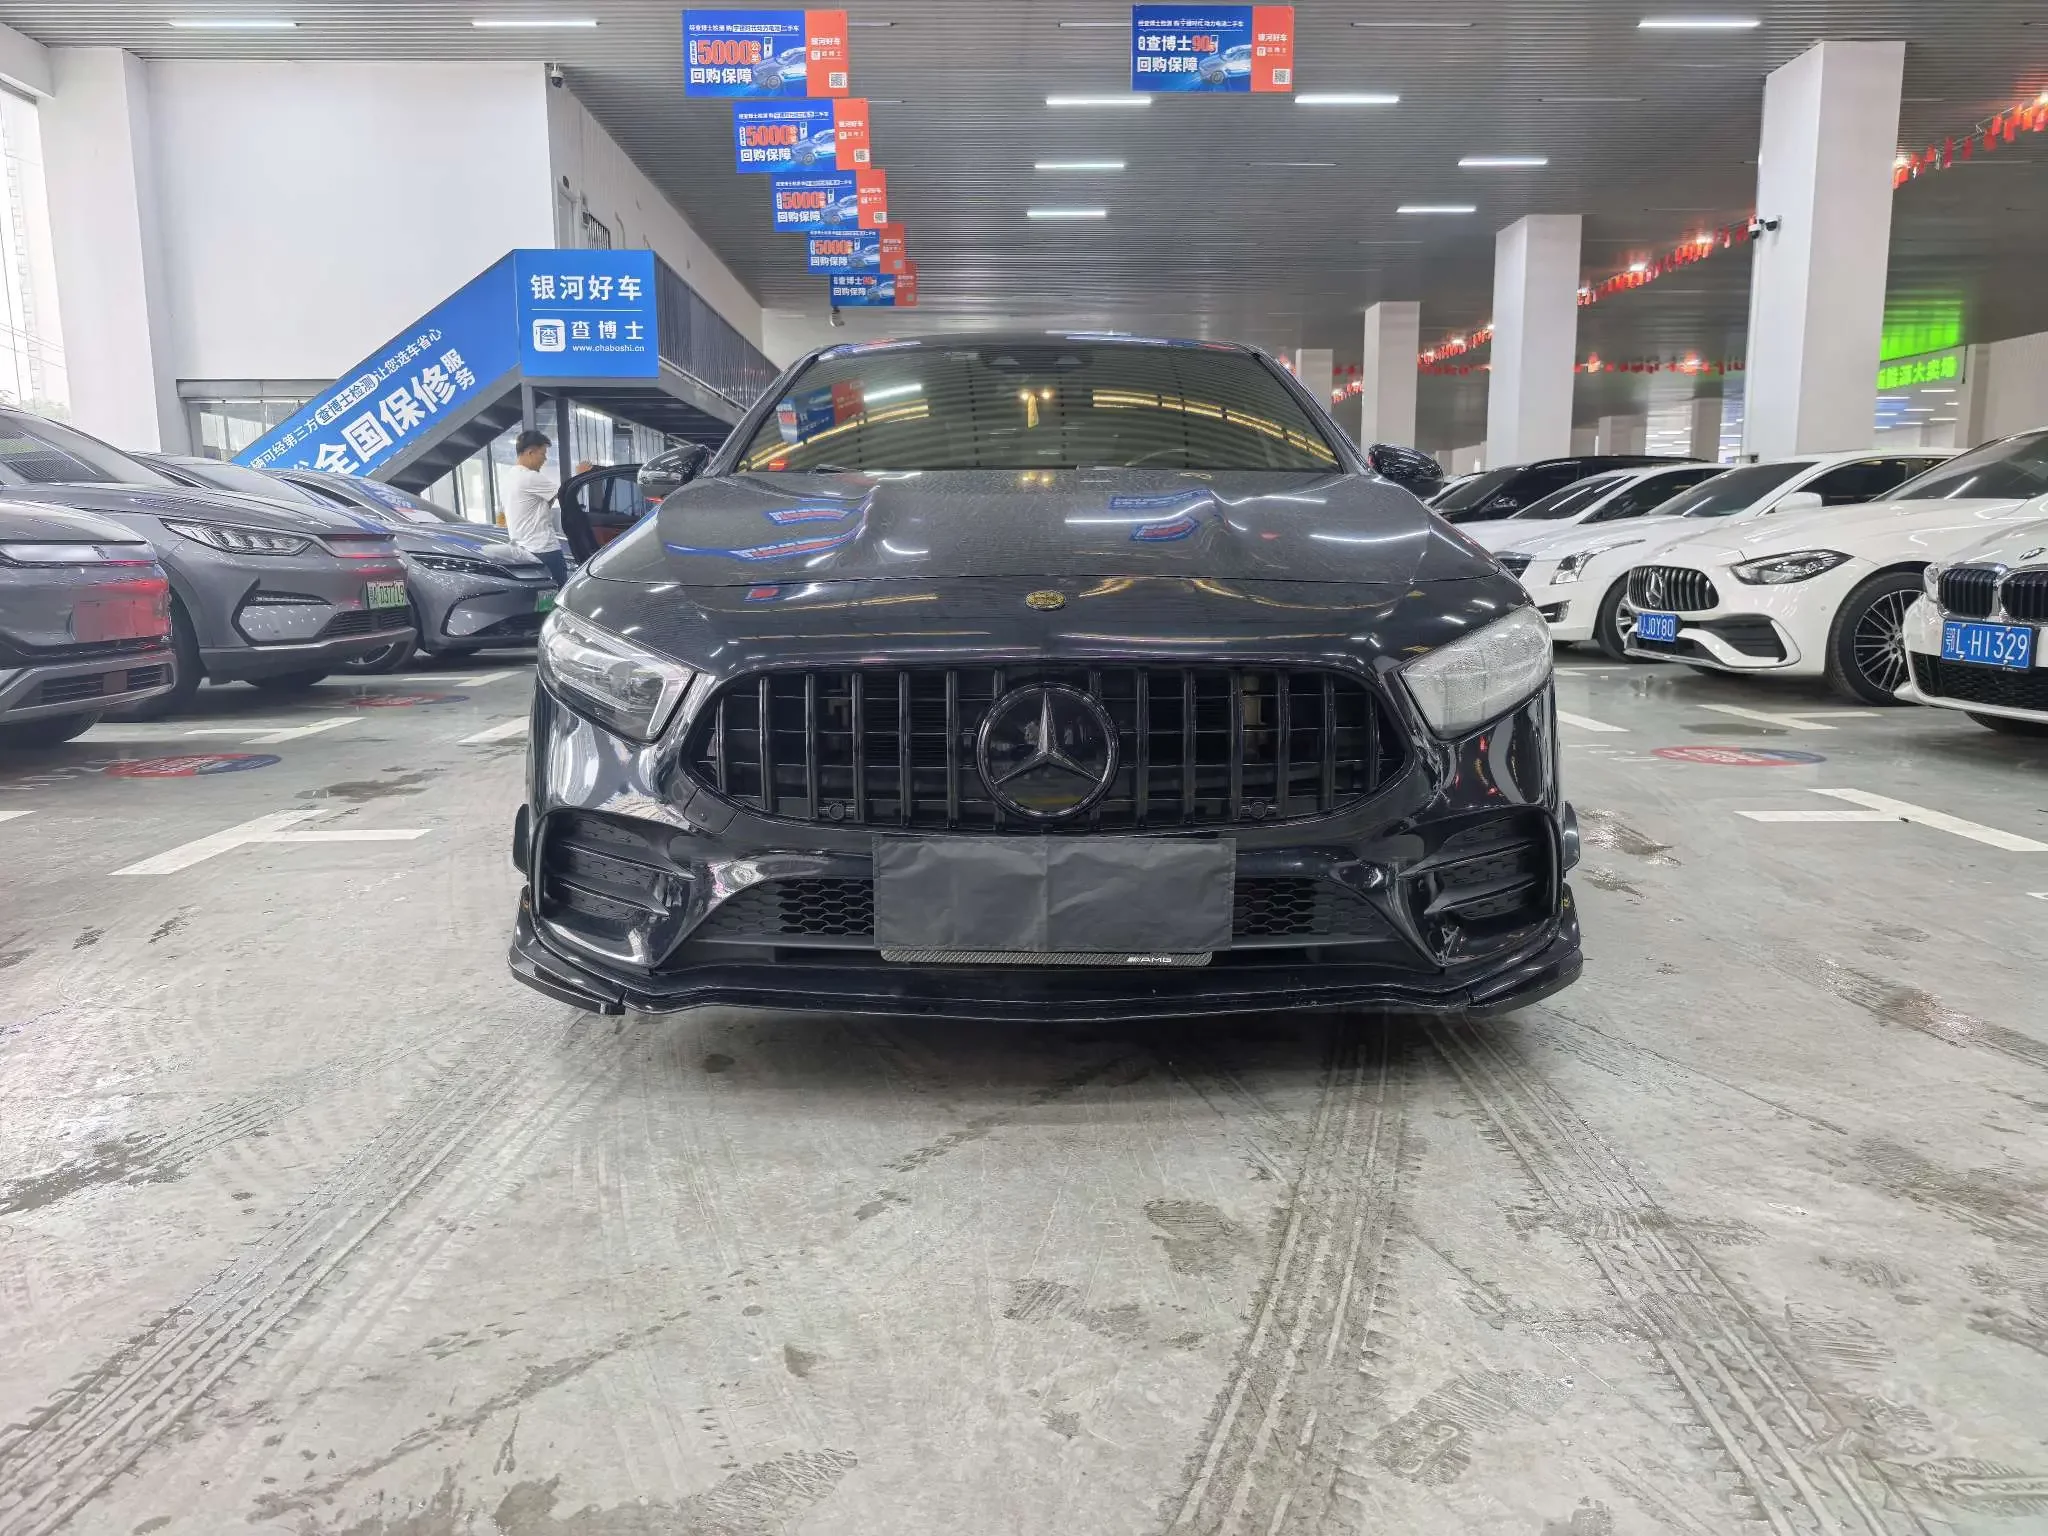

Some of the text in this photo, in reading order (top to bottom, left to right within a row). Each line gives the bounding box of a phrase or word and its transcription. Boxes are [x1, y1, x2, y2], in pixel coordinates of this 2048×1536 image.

[697, 40, 752, 65] 5000
[1136, 56, 1199, 73] 回购保障
[690, 67, 752, 84] 回购保障
[745, 125, 792, 147] 5000
[740, 148, 792, 162] 回购保障
[777, 211, 821, 223] 回购保障
[530, 274, 643, 301] 银河好车
[571, 320, 644, 340] 查博士
[572, 344, 645, 352] www.chaboshi.cn
